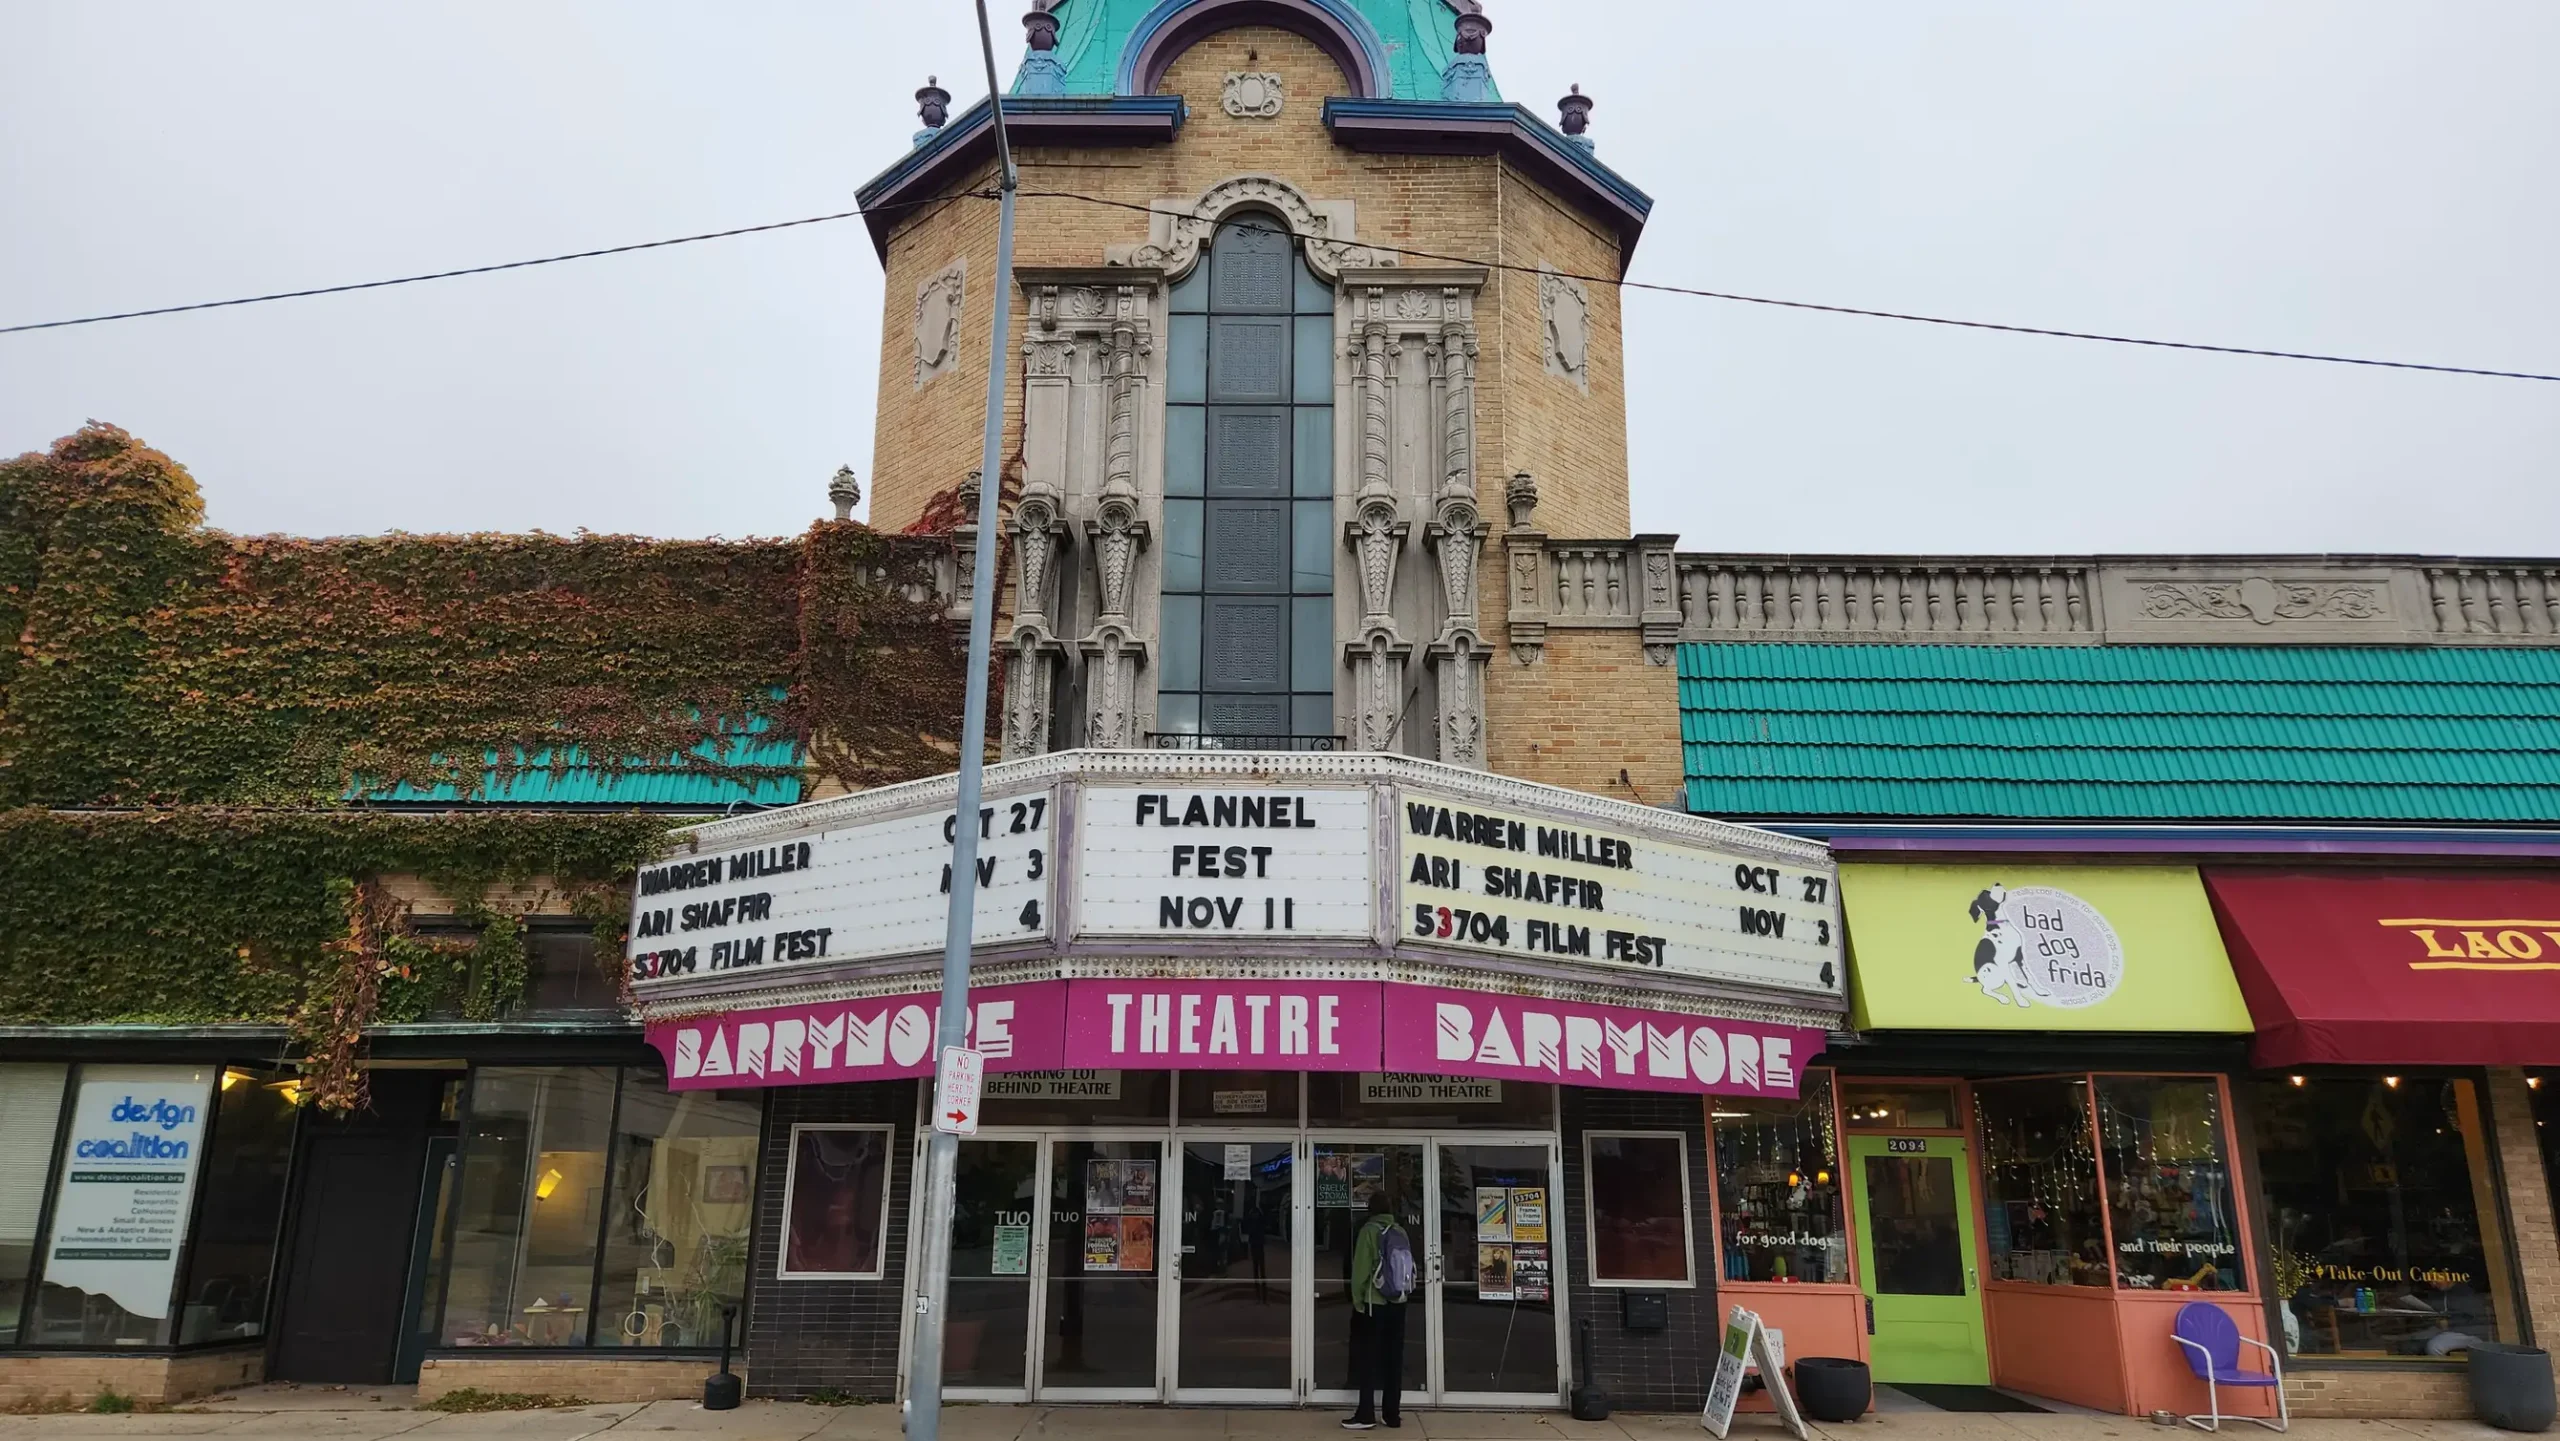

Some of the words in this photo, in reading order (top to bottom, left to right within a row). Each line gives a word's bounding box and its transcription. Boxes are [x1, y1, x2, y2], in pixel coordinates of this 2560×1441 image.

[1136, 794, 1316, 828] FLANNEL
[641, 857, 722, 896] WARREN
[729, 841, 811, 881] MILLER
[1010, 798, 1046, 834] 27
[1407, 802, 1526, 851] WARREN
[1537, 826, 1633, 870] MILLER
[1735, 864, 1780, 895] OCT
[1803, 876, 1828, 903] 27
[1172, 845, 1272, 878] FEST
[637, 908, 673, 937] ARI
[680, 892, 771, 931] SHAFFIR
[1027, 849, 1043, 879] 3
[1410, 853, 1460, 890] ARI
[1484, 865, 1604, 911] SHAFFIR
[1740, 905, 1786, 938] NOV
[1818, 919, 1830, 946] 3
[1160, 895, 1243, 929] NOV
[1265, 897, 1293, 929] 11
[2023, 905, 2064, 932] bad
[634, 946, 697, 980] 53704
[710, 936, 764, 969] FILM
[773, 927, 832, 962] FEST
[1019, 899, 1041, 929] 4
[1415, 903, 1510, 947] 53704
[1527, 919, 1590, 957] FILM
[1607, 929, 1667, 967] FEST
[1820, 961, 1835, 989] 4
[2037, 933, 2080, 959] dog
[2409, 929, 2542, 960] LAO
[2048, 959, 2106, 988] frida
[1107, 994, 1339, 1054] THEATRE
[1436, 1002, 1794, 1092] BARRYMORE
[957, 1056, 970, 1070] NO
[948, 1084, 963, 1094] HERE
[949, 1073, 975, 1083] PARKING
[966, 1086, 974, 1095] TO
[987, 1081, 1042, 1094] BEHIND
[1049, 1082, 1112, 1095] THEATRE
[1368, 1085, 1422, 1098] BEHIND
[1429, 1085, 1493, 1098] THEATRE
[112, 1096, 195, 1130] design
[947, 1096, 972, 1107] CORNER
[76, 1132, 189, 1159] coalition
[1889, 1140, 1926, 1151] 2094
[1514, 1192, 1540, 1203] 53704
[1185, 1211, 1197, 1222] IN
[1408, 1214, 1420, 1225] IN
[1736, 1231, 1757, 1246] for
[1761, 1231, 1796, 1247] good
[1801, 1231, 1833, 1250] dogs
[2120, 1238, 2144, 1253] and
[2325, 1264, 2402, 1281] Take-Out
[2409, 1266, 2471, 1283] Cuisine
